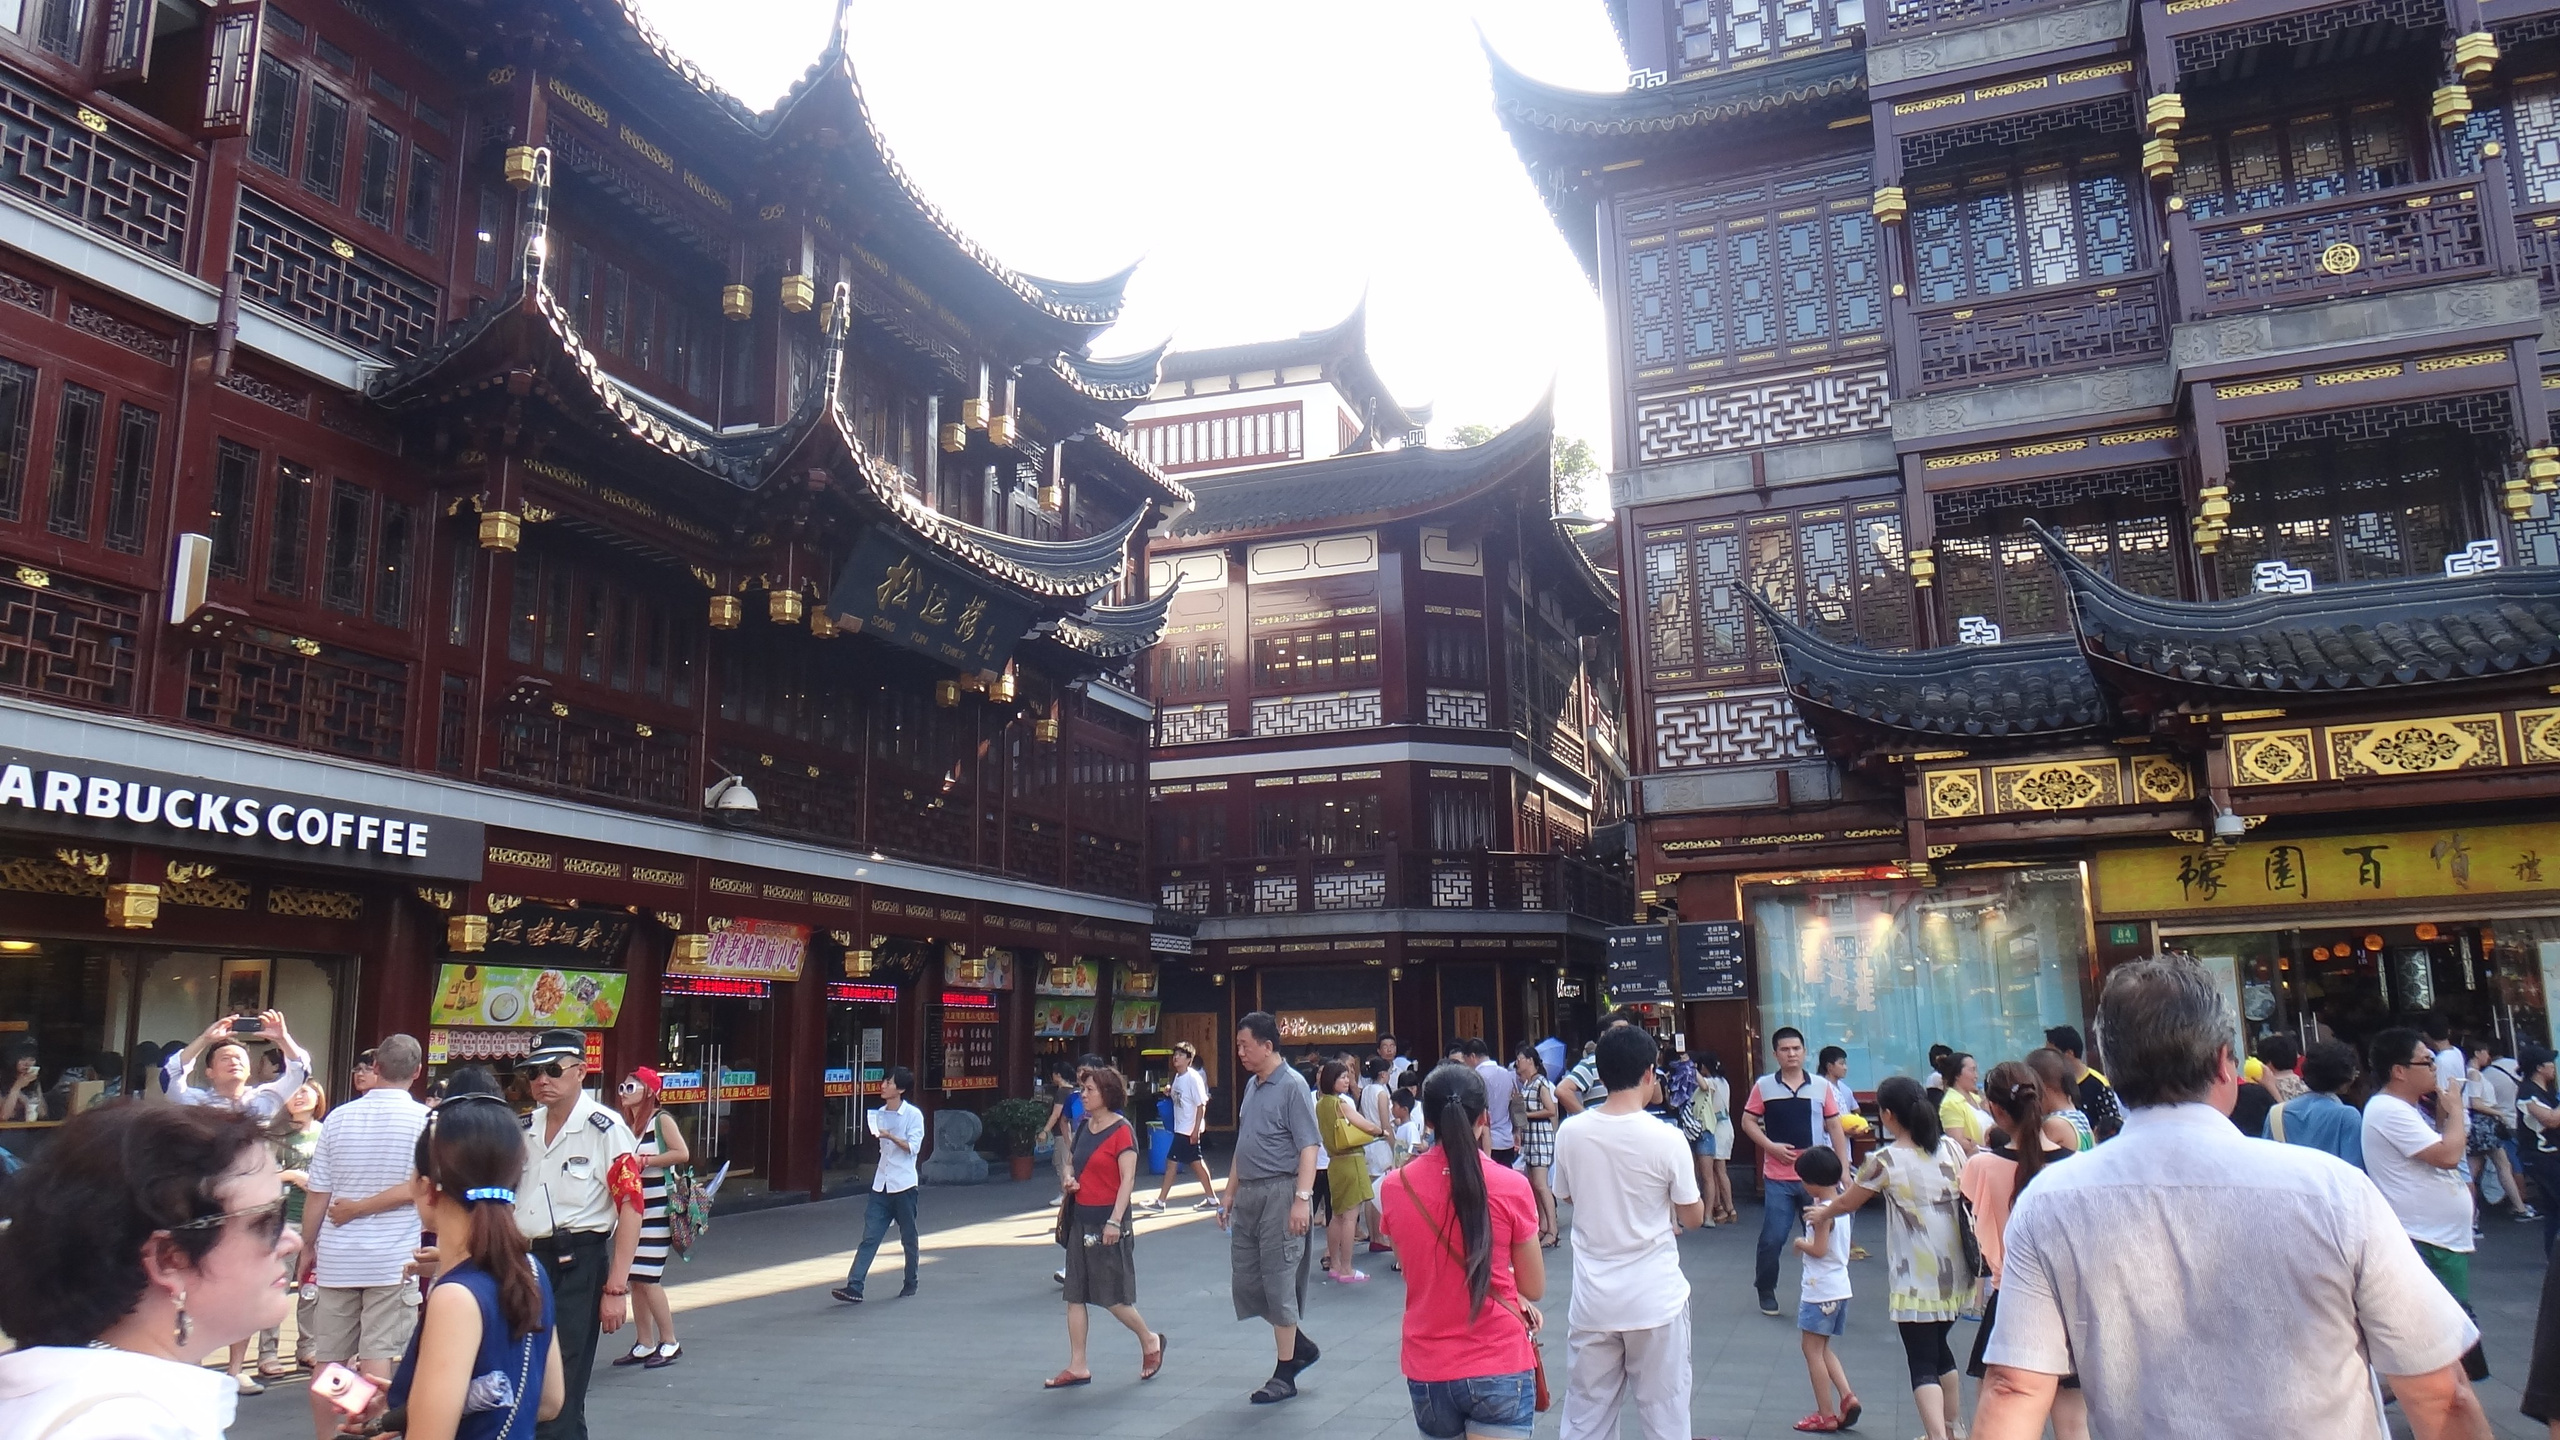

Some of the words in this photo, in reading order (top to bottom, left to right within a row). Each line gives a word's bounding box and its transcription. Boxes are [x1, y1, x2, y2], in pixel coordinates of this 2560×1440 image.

[870, 614, 897, 633] SONG
[910, 631, 929, 646] YUN
[940, 643, 968, 661] TOWER
[267, 803, 429, 858] COFFEE
[2117, 928, 2132, 939] 84
